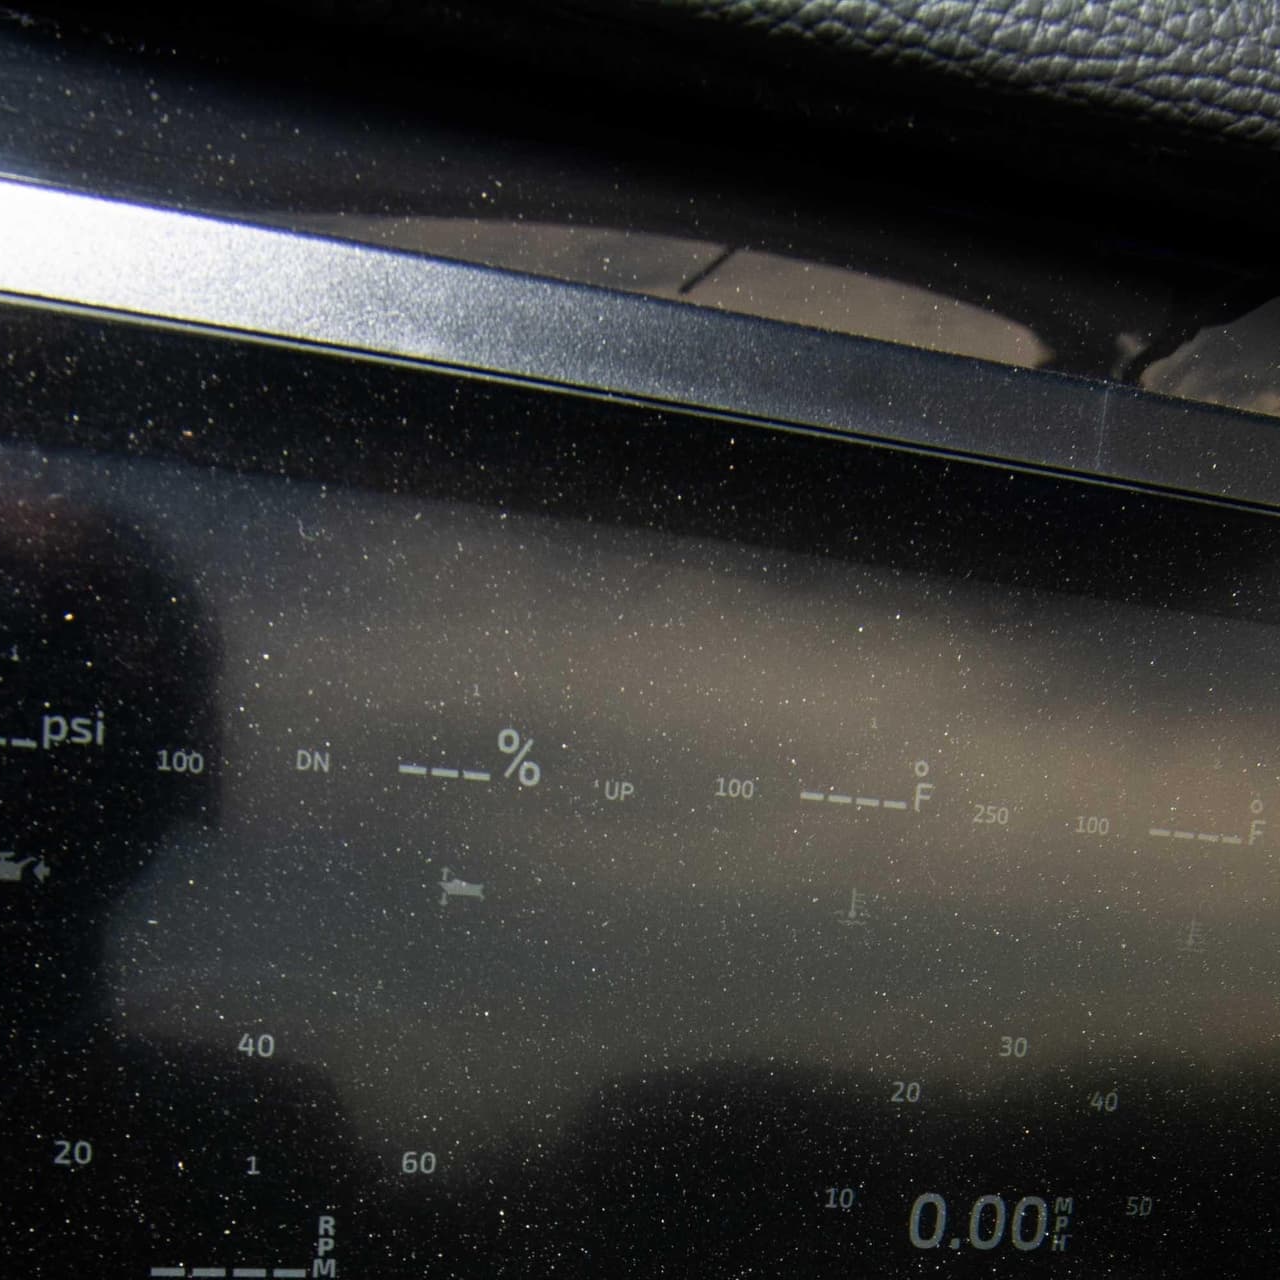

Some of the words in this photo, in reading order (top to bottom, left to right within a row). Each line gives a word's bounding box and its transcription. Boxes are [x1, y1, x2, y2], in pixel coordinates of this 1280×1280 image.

[157, 750, 204, 773] 100
[295, 750, 330, 772] DN
[604, 781, 635, 800] UP
[715, 777, 754, 799] 100
[973, 804, 1009, 825] 250
[1075, 816, 1110, 836] 100
[237, 1034, 275, 1058] 40
[999, 1036, 1028, 1058] 30
[891, 1081, 921, 1103] 20
[1089, 1091, 1119, 1113] 40
[53, 1141, 92, 1165] 20
[401, 1151, 437, 1174] 60
[246, 1156, 260, 1175] 1
[825, 1186, 854, 1209] 10
[909, 1192, 1049, 1251] 0.00
